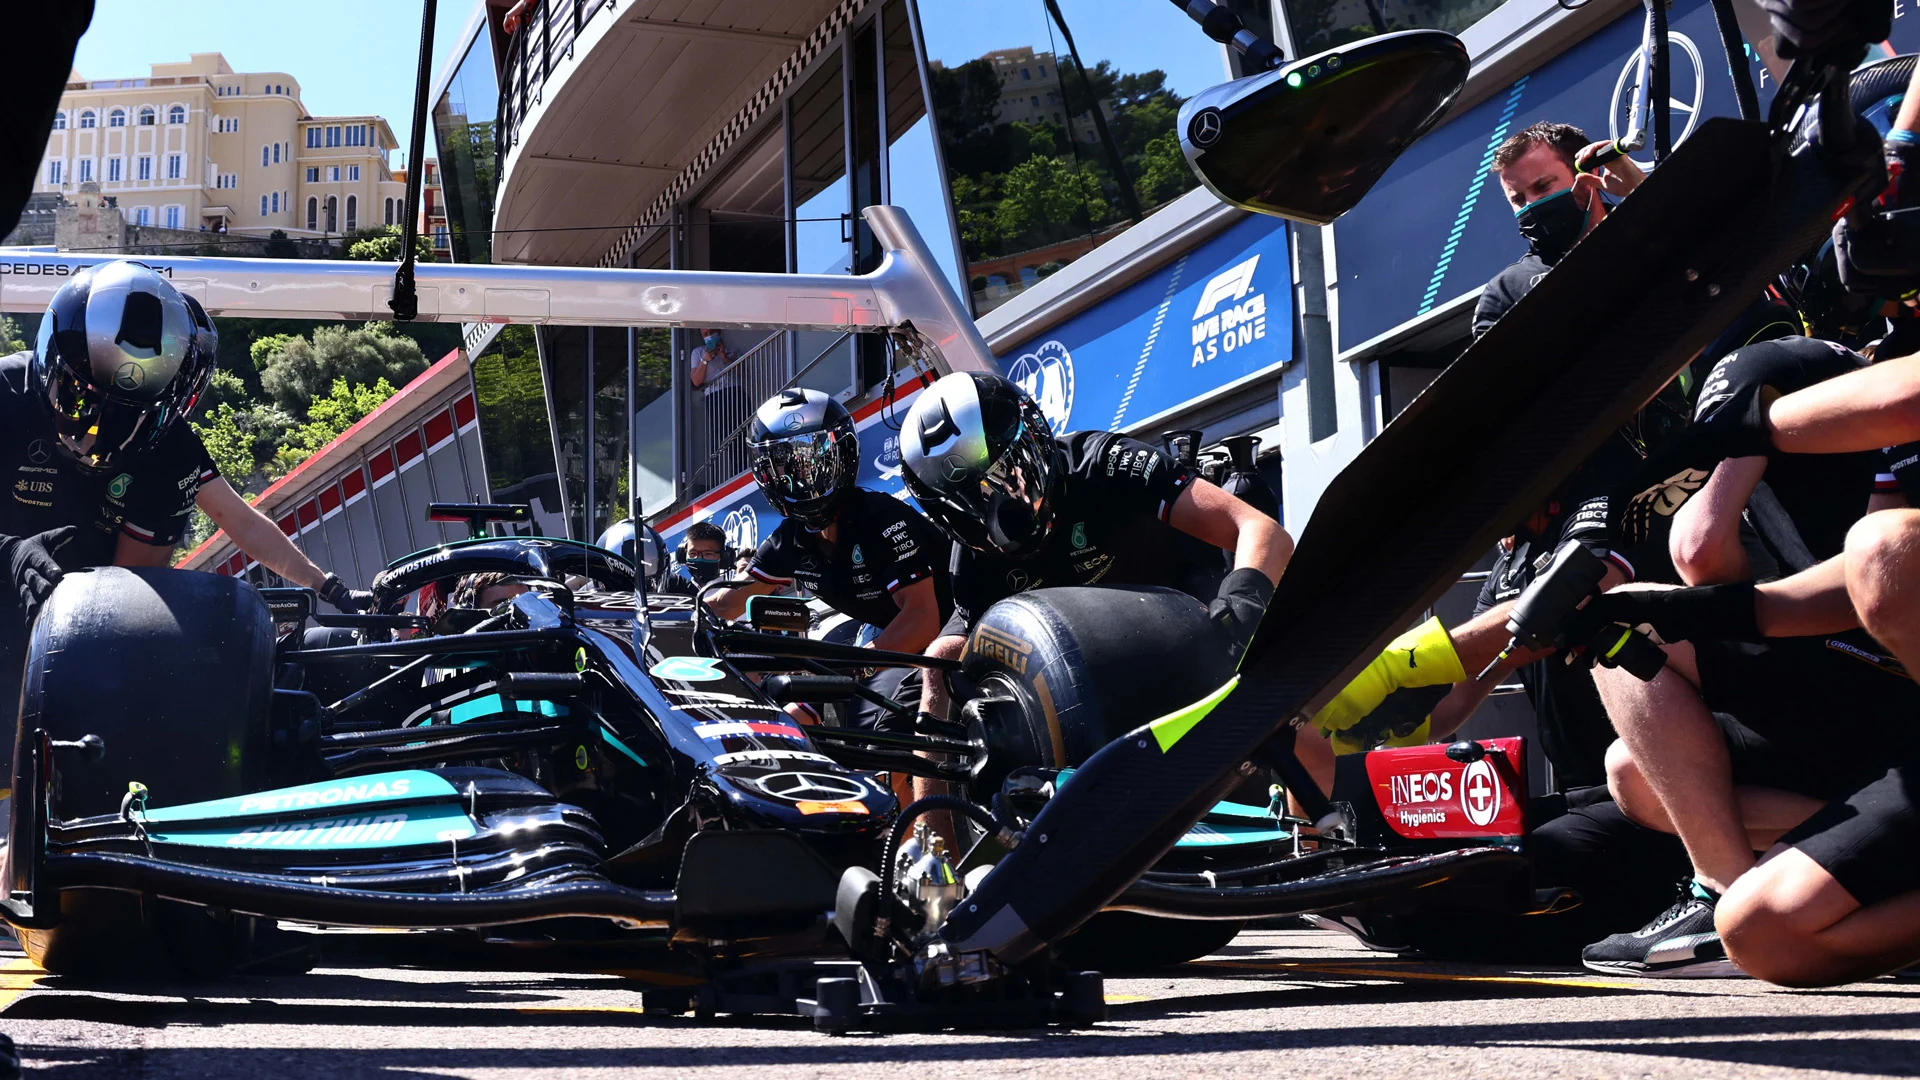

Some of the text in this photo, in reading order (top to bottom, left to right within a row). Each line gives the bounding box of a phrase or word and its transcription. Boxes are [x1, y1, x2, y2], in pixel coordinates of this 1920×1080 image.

[1191, 293, 1266, 347] WE RACE
[1191, 316, 1266, 368] AS ONE
[1106, 440, 1122, 477] EPSON
[1118, 451, 1133, 472] IWC
[30, 481, 53, 493] UBS
[882, 520, 907, 538] EPSON
[892, 530, 909, 544] IWC
[383, 551, 451, 584] CROWDSTRIKE
[1073, 553, 1109, 574] INEOS
[973, 622, 1033, 676] PIRELLI
[239, 779, 411, 813] PETRONAS
[1390, 771, 1453, 805] INEOS
[1400, 808, 1446, 828] Hygienics
